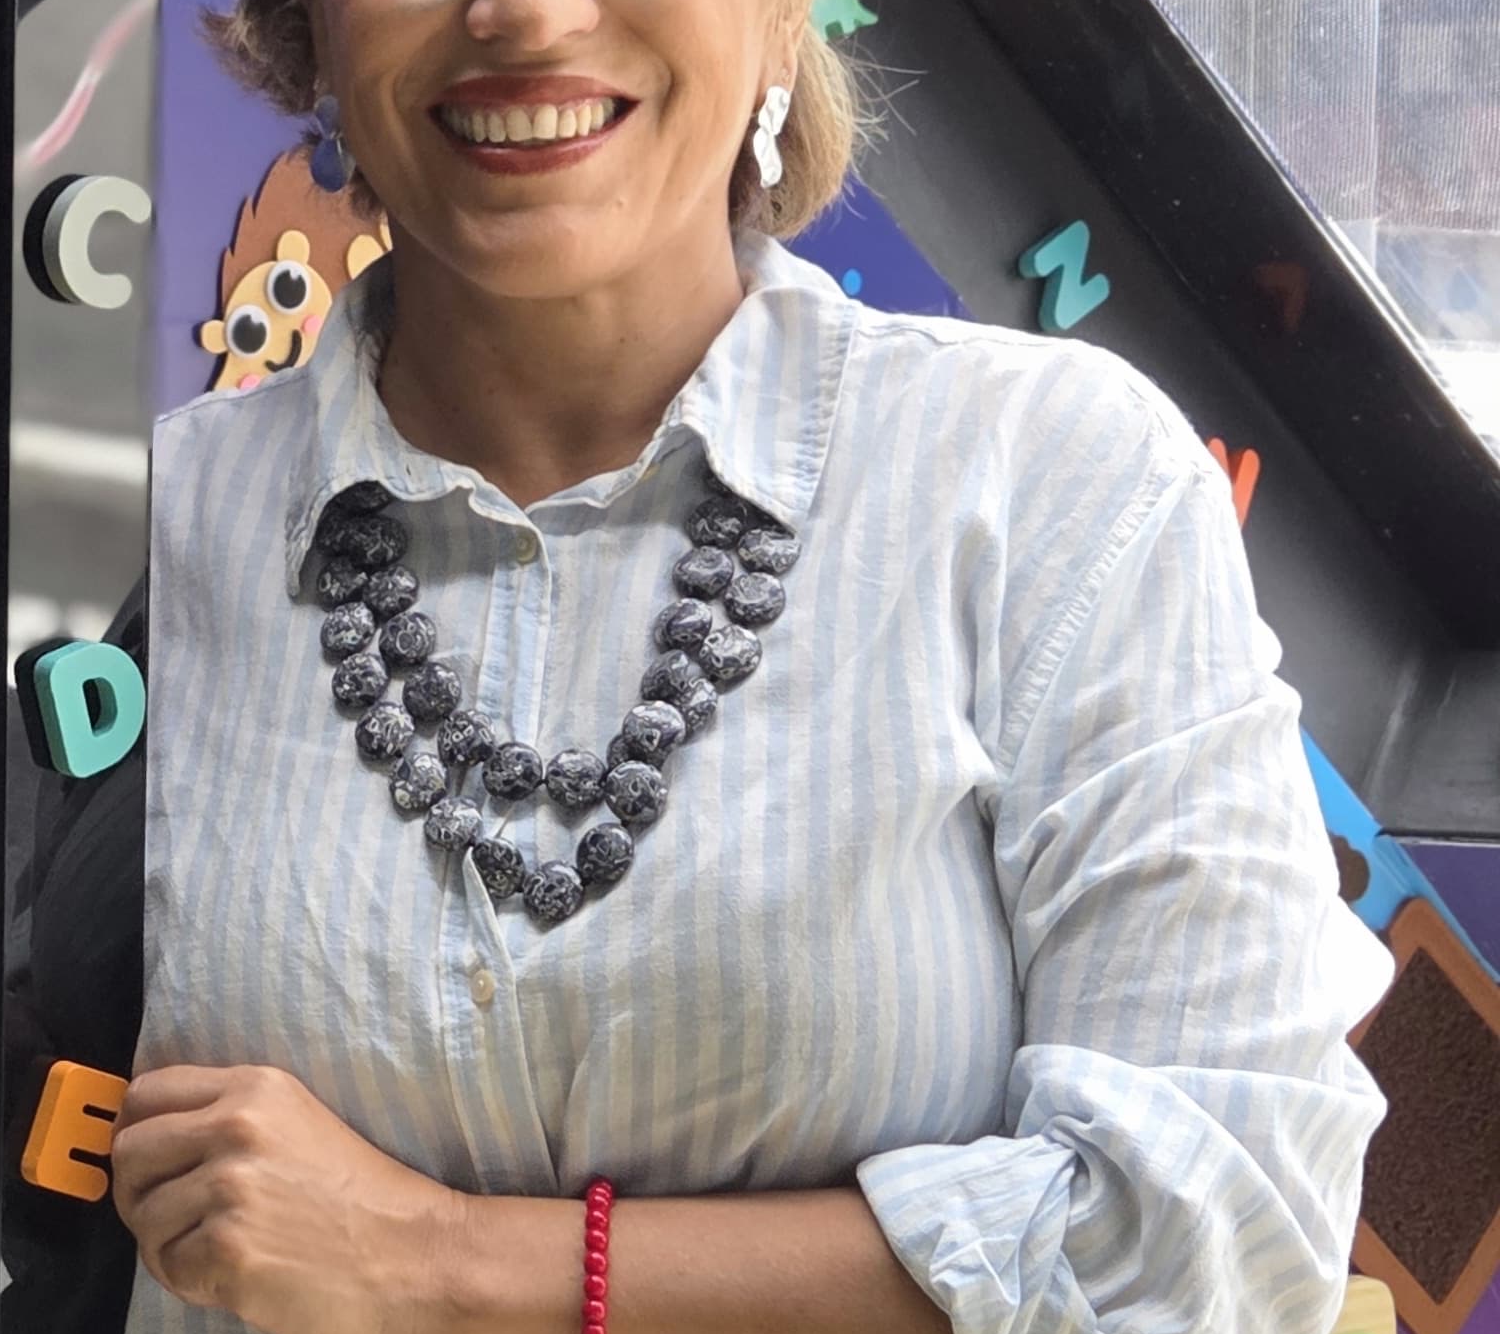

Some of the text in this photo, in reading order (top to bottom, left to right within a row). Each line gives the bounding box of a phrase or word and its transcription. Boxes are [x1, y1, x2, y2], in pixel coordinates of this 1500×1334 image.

[44, 175, 152, 309] C
[34, 639, 146, 778] D
[20, 1059, 130, 1201] E
